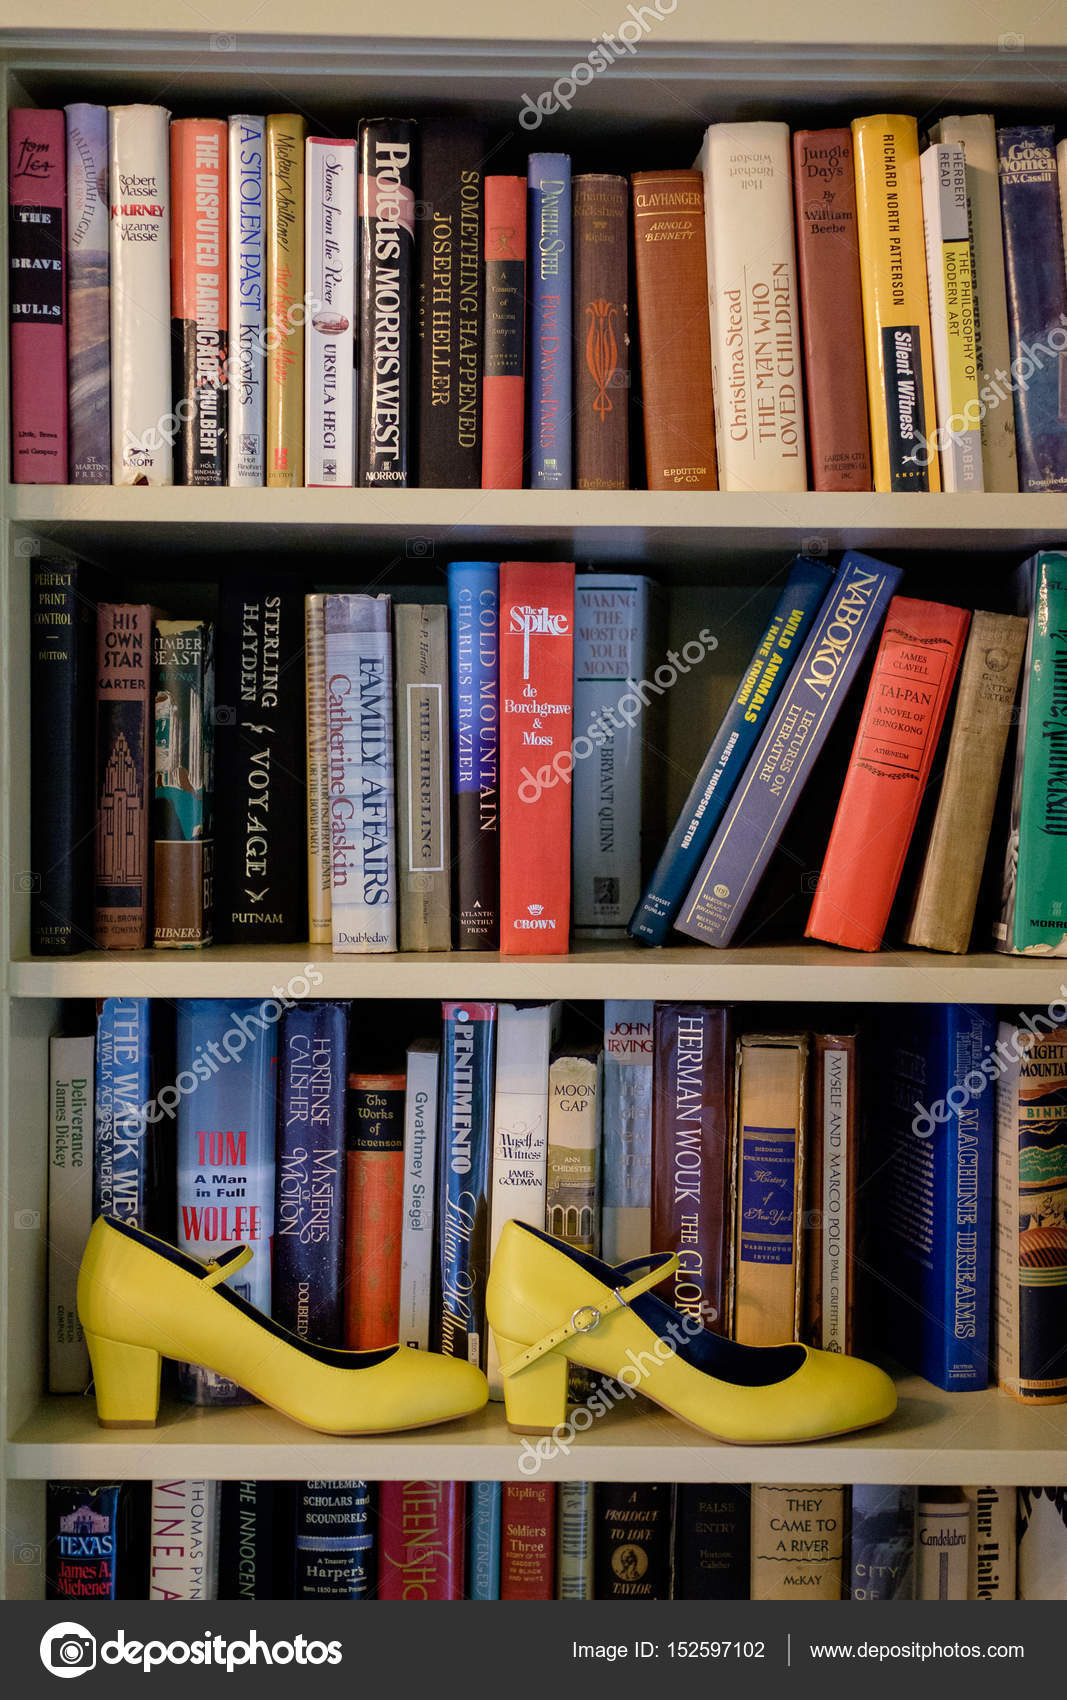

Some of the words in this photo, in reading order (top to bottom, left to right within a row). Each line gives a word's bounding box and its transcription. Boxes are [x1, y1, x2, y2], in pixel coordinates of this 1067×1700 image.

[196, 134, 220, 168] THE
[240, 125, 262, 144] A
[1008, 143, 1052, 161] Goss
[800, 145, 850, 169] Jungle
[807, 163, 844, 183] Days
[883, 134, 898, 187] RICHARD
[940, 152, 952, 187] READ
[323, 153, 343, 202] Stones
[952, 152, 966, 209] HERBERT
[20, 212, 51, 224] THE
[111, 204, 164, 220] JOURNEY
[240, 150, 262, 246] STOLEN
[375, 141, 410, 260] Proteus
[637, 192, 701, 208] CLAYHANGER
[887, 193, 901, 232] NORTH
[196, 174, 220, 267] DISPUTED
[645, 230, 697, 242] BENNETT
[650, 220, 692, 232] ARNOLD
[323, 238, 340, 261] the
[432, 211, 453, 305] JOSEPH
[459, 170, 480, 314] SOMETHING
[12, 259, 62, 271] BRAVE
[240, 253, 262, 312] PAST
[323, 261, 343, 306] River
[889, 237, 905, 306] PATTERSON
[945, 255, 958, 305] MODERN
[959, 250, 970, 281] THE
[12, 303, 61, 316] BULLS
[375, 266, 401, 375] MORRIS
[723, 288, 744, 347] Stead
[752, 283, 773, 335] WHO
[773, 262, 795, 378] CHILDREN
[948, 311, 960, 337] ART
[960, 283, 976, 360] PHILOSOPHY
[196, 273, 220, 386] BARRICADE
[240, 323, 261, 406] Knowles
[432, 309, 452, 406] HELLER
[754, 341, 775, 390] MAN
[894, 331, 913, 376] Silent
[964, 365, 976, 381] OF
[323, 343, 337, 405] URSULA
[458, 320, 479, 448] HAPPENED
[730, 348, 749, 442] Christina
[897, 380, 917, 440] Witness
[199, 387, 218, 457] HULBERT
[323, 410, 337, 450] HEGI
[375, 377, 401, 460] WEST
[757, 396, 777, 444] THE
[779, 384, 799, 459] LOVED
[366, 471, 408, 480] MORROW
[961, 435, 975, 481] FABER
[524, 605, 539, 615] The
[577, 592, 638, 609] MAKING
[592, 610, 624, 626] THE
[105, 631, 144, 649] OWN
[112, 613, 139, 630] HIS
[457, 588, 474, 690] CHARLES
[479, 589, 497, 667] COLD
[578, 626, 615, 642] MOST
[758, 625, 781, 657] HAVE
[778, 609, 805, 650] WILD
[803, 566, 880, 701] NABOKOV
[103, 651, 144, 668] STAR
[241, 602, 260, 702] HAYDEN
[262, 595, 281, 708] STERLING
[589, 642, 628, 659] YOUR
[892, 662, 929, 676] CLAVELL
[899, 649, 928, 665] JAMES
[522, 684, 538, 698] de
[737, 660, 765, 705] KNOWN
[744, 652, 785, 723] ANIMALS
[880, 683, 934, 706] TAI-PAN
[359, 656, 388, 773] FAMILY
[504, 699, 571, 718] Borchgrave
[532, 718, 544, 729] &
[884, 706, 913, 720] NOVEL
[913, 711, 926, 723] OF
[328, 673, 353, 795] Catherine
[458, 695, 474, 783] FRAZIER
[521, 731, 553, 746] Moss
[759, 703, 803, 784] LITERATURE
[780, 709, 817, 775] LECTURES
[479, 684, 498, 832] MOUNTAIN
[600, 747, 615, 804] BRYANT
[419, 749, 433, 858] HIRELING
[695, 767, 724, 820] THOMPSON
[768, 773, 788, 797] ON
[245, 749, 270, 878] VOYAGE
[598, 807, 615, 854] QUINN
[680, 818, 701, 849] SETON
[331, 797, 356, 888] Gaskin
[361, 776, 391, 906] AFFAIRS
[231, 911, 284, 923] PUTNAM
[513, 918, 557, 930] CROWN
[338, 931, 390, 944] Doubleday
[101, 1030, 112, 1040] A
[113, 999, 139, 1066] THE
[607, 1039, 656, 1057] IRVING
[610, 1022, 651, 1036] JOHN
[101, 1045, 112, 1081] WALK
[286, 1034, 312, 1127] CALISHER
[311, 1038, 332, 1127] HORTENSE
[676, 1015, 704, 1123] HERMAN
[828, 1054, 843, 1106] MYSELF
[55, 1080, 70, 1121] James
[365, 1093, 388, 1107] The
[450, 1024, 474, 1175] PENTIMENTO
[553, 1084, 597, 1097] MOON
[559, 1100, 589, 1113] GAP
[71, 1079, 88, 1171] Deliverance
[113, 1071, 139, 1161] WALK
[357, 1106, 395, 1120] Works
[368, 1123, 381, 1137] of
[828, 1111, 843, 1149] AND
[54, 1125, 70, 1169] Dickey
[194, 1130, 248, 1166] TOM
[408, 1091, 429, 1178] Gwathmey
[100, 1144, 112, 1209] AMERICA
[193, 1174, 212, 1184] A
[212, 1174, 247, 1185] Man
[674, 1128, 702, 1205] WOUK
[827, 1152, 843, 1213] MARCO
[957, 1107, 979, 1225] MACHINE
[196, 1187, 211, 1198] in
[217, 1187, 246, 1198] Full
[309, 1149, 340, 1243] MYSTERIES
[409, 1184, 428, 1231] Siegel
[181, 1205, 262, 1241] WOLFE
[681, 1213, 700, 1244] THE
[827, 1217, 842, 1257] POLO
[829, 1259, 840, 1284] PAUL
[954, 1231, 978, 1340] DREAMS
[829, 1286, 840, 1337] GRIFFITHS
[303, 1495, 353, 1507] SCHOLARS
[507, 1487, 546, 1503] Kipling
[628, 1490, 637, 1503] A
[786, 1498, 823, 1512] THEY
[306, 1511, 368, 1524] SCOUNDRELS
[507, 1524, 547, 1538] Soldiers
[769, 1517, 813, 1532] CAME
[815, 1518, 837, 1532] TO
[57, 1535, 113, 1554] TEXAS
[509, 1538, 544, 1553] Three
[775, 1540, 786, 1552] A
[790, 1539, 830, 1553] RIVER
[783, 1574, 823, 1586] McKAY
[854, 1562, 900, 1578] CITY
